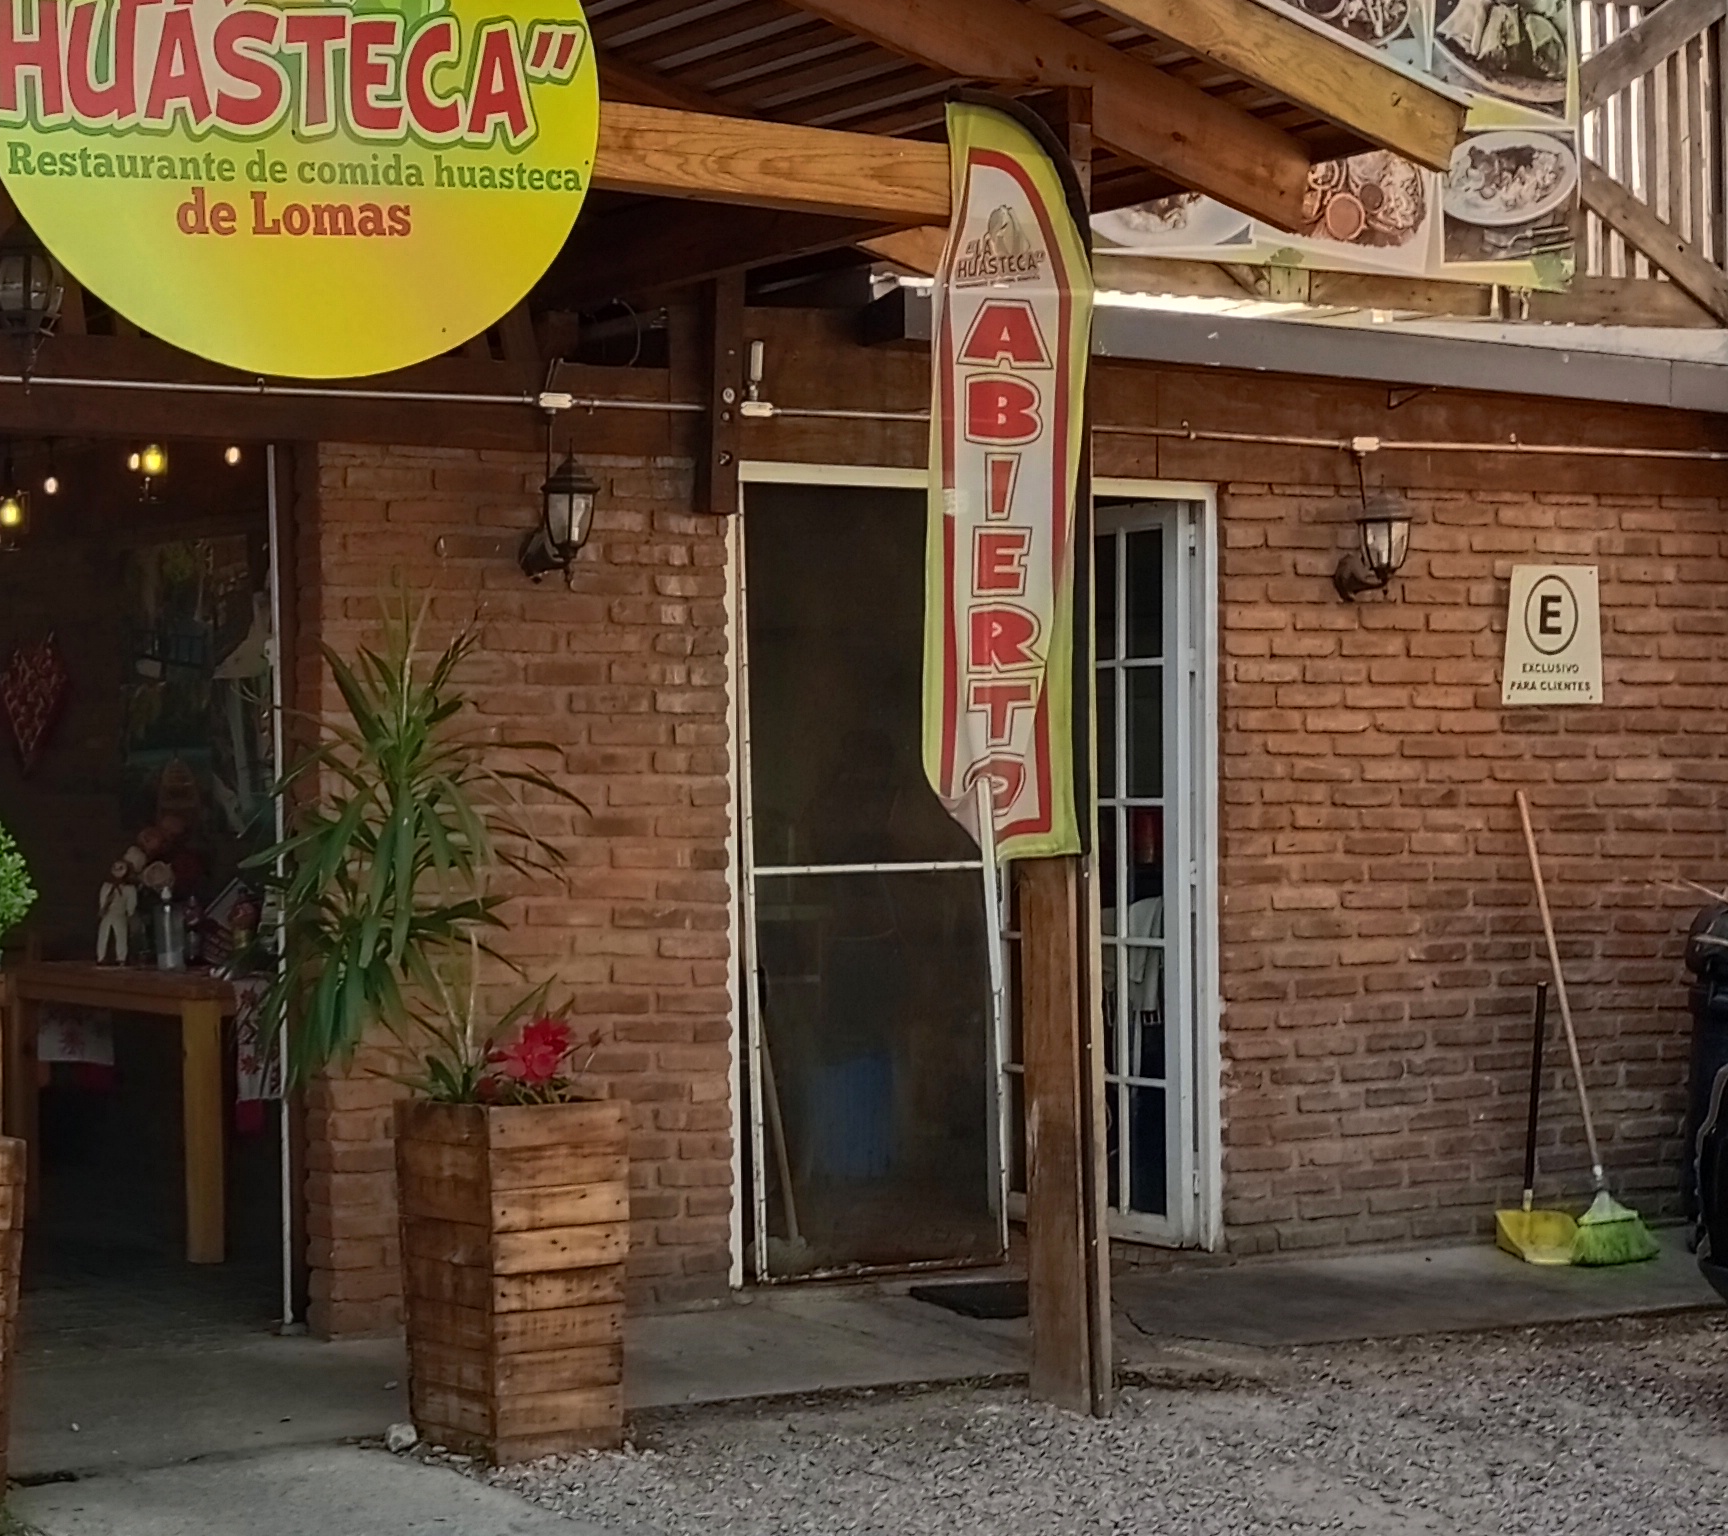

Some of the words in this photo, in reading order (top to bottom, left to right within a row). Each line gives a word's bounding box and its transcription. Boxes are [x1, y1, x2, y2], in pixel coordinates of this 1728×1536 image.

[7, 140, 236, 184] Restaurante
[245, 148, 289, 184] de
[296, 152, 425, 188] comida
[435, 155, 583, 192] huasteca
[177, 187, 237, 235] de
[251, 190, 412, 236] Lomas
[1539, 595, 1562, 635] E
[1510, 681, 1537, 691] PARA
[1540, 681, 1592, 692] CLIENTES
[1522, 663, 1580, 674] EXCLUSIVO
